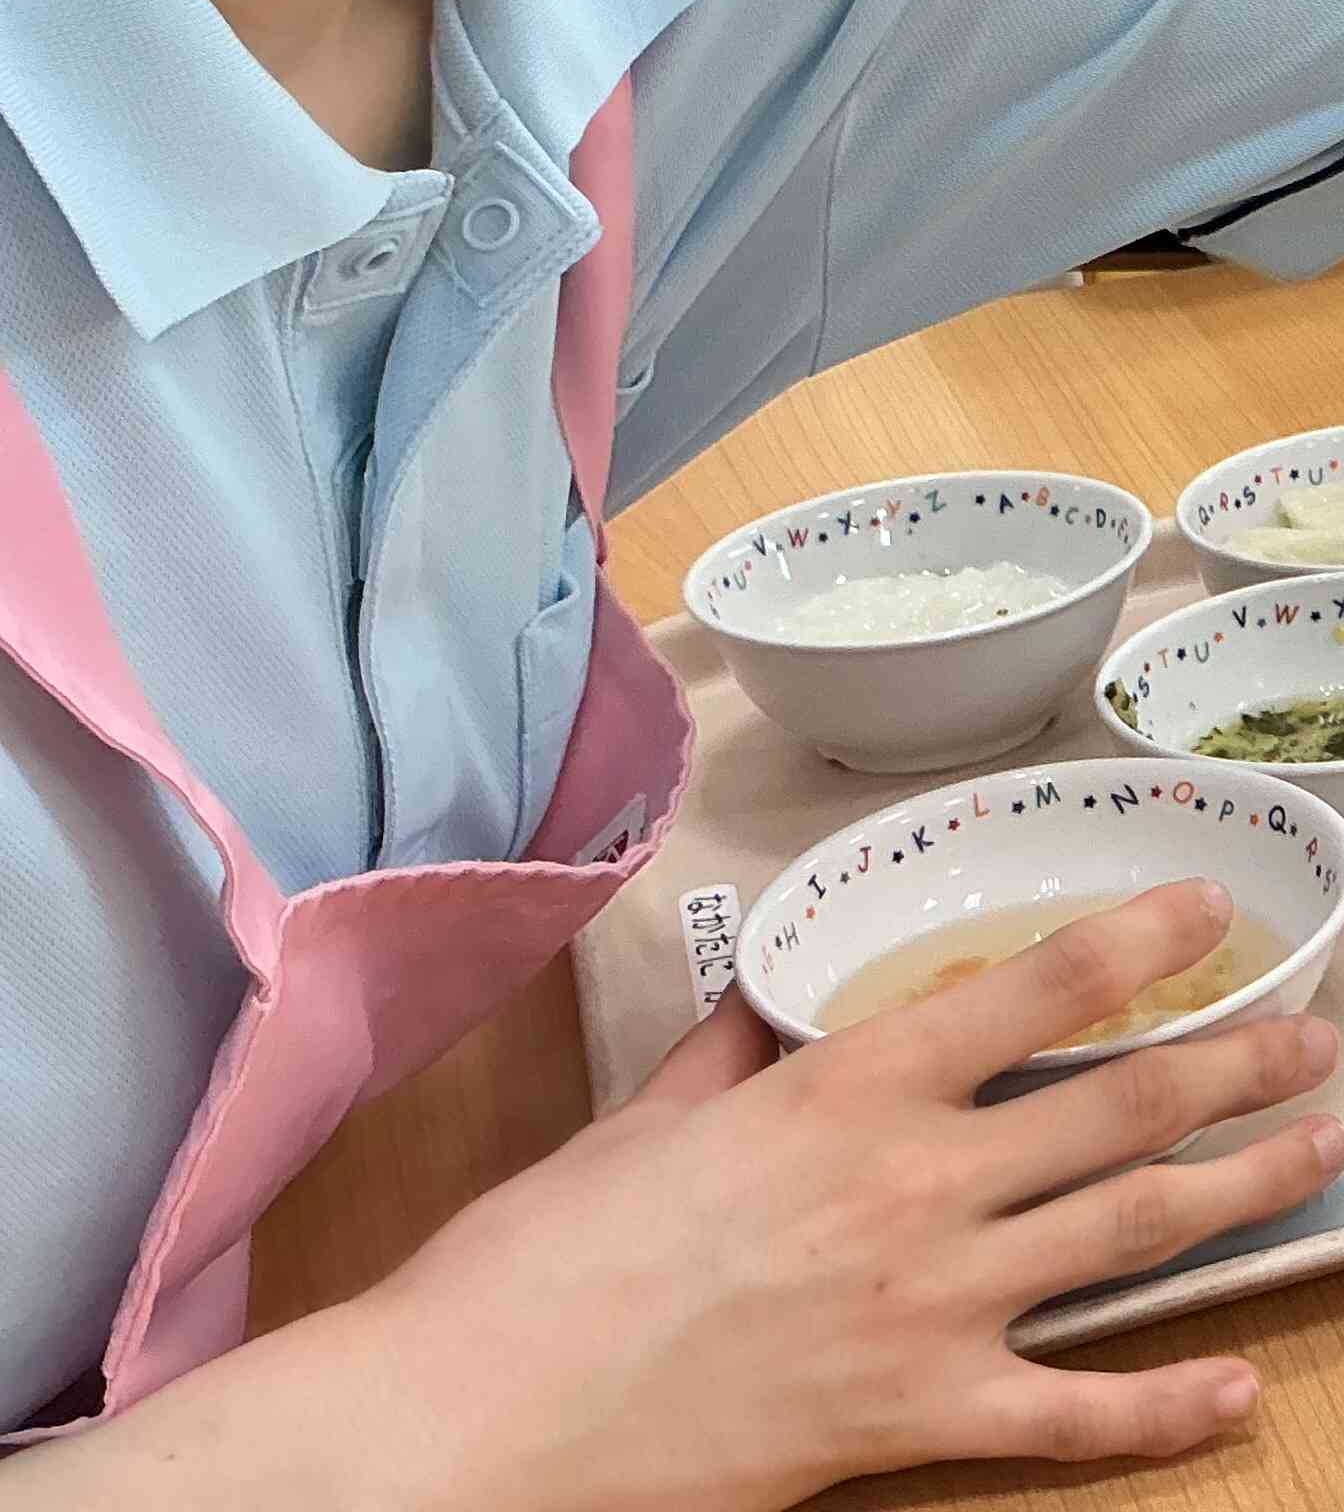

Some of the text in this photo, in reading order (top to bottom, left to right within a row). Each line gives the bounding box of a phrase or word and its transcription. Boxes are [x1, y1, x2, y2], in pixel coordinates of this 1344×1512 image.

[753, 534, 767, 556] V
[787, 528, 808, 548] W
[837, 511, 859, 535] X
[925, 489, 947, 512] Z
[999, 493, 1014, 514] A
[1035, 486, 1049, 507] B
[1064, 506, 1079, 525] C
[1096, 508, 1107, 528] D
[1243, 485, 1256, 506] S
[1270, 467, 1282, 485] T
[1308, 467, 1324, 486] U
[1138, 676, 1150, 698] S
[1157, 648, 1168, 668] T
[1194, 641, 1210, 663] U
[1232, 605, 1247, 628] V
[1275, 603, 1300, 625] W
[783, 922, 801, 951] H
[807, 874, 827, 900] I
[857, 845, 872, 873] J
[911, 825, 935, 854] K
[972, 792, 991, 818] L
[1035, 781, 1061, 809] M
[1110, 784, 1139, 815] N
[1173, 781, 1194, 804] O
[1218, 799, 1235, 822] P
[1268, 805, 1287, 834] Q
